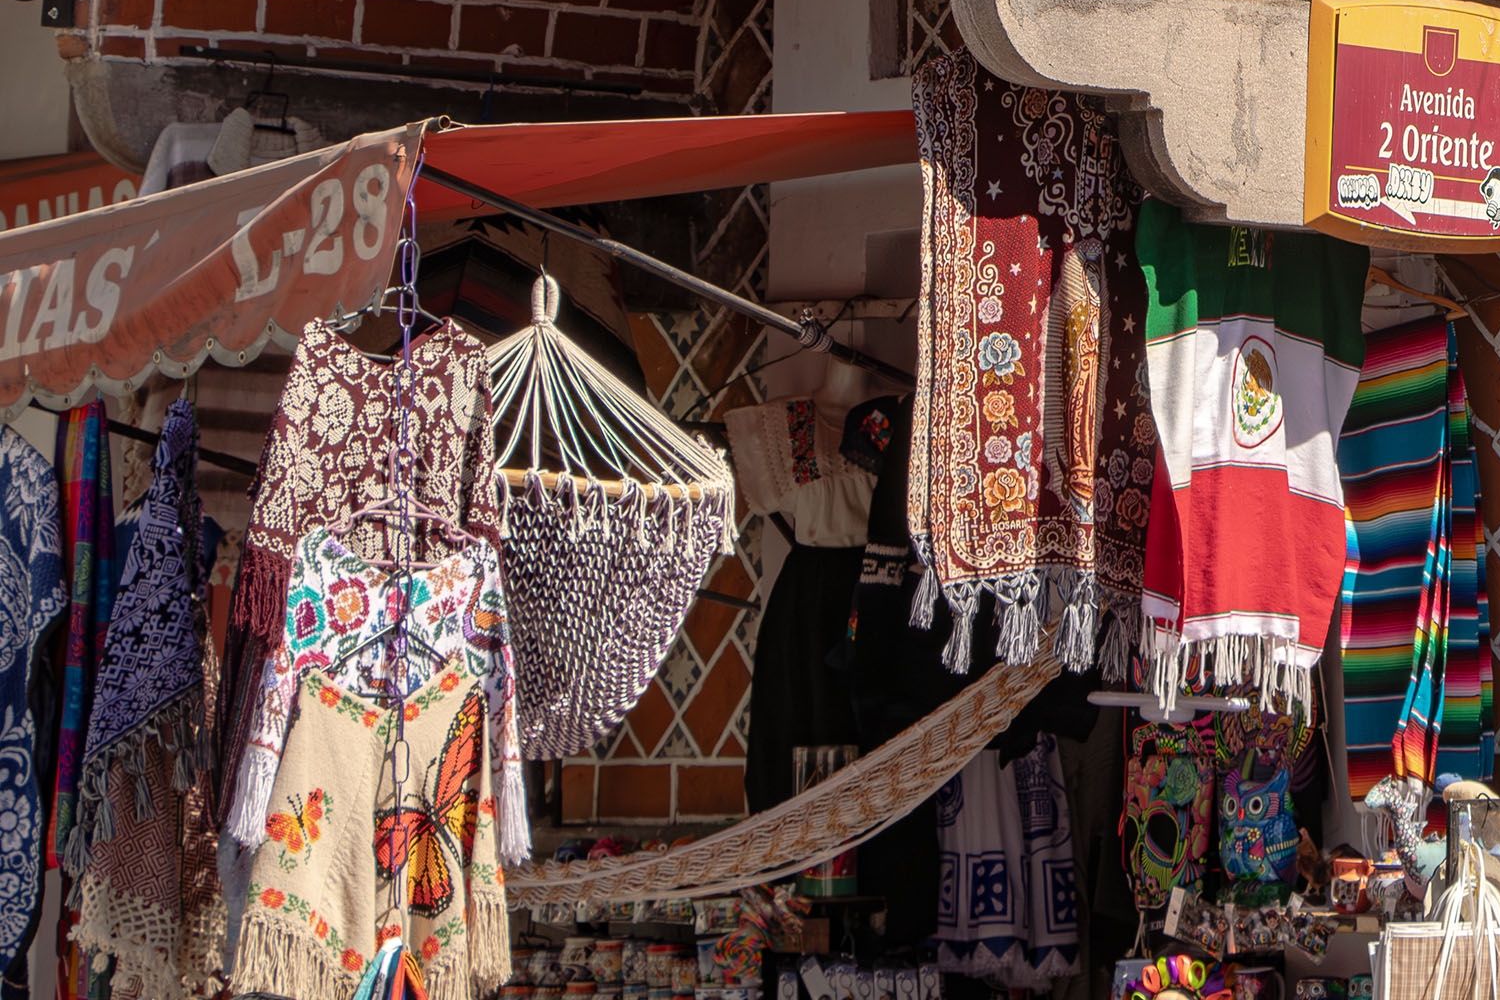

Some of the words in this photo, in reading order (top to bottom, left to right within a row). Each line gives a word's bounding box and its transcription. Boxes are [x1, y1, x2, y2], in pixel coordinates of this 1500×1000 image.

[1400, 83, 1475, 120] Avenida
[1378, 122, 1393, 158] 2
[1402, 125, 1494, 170] Oriente
